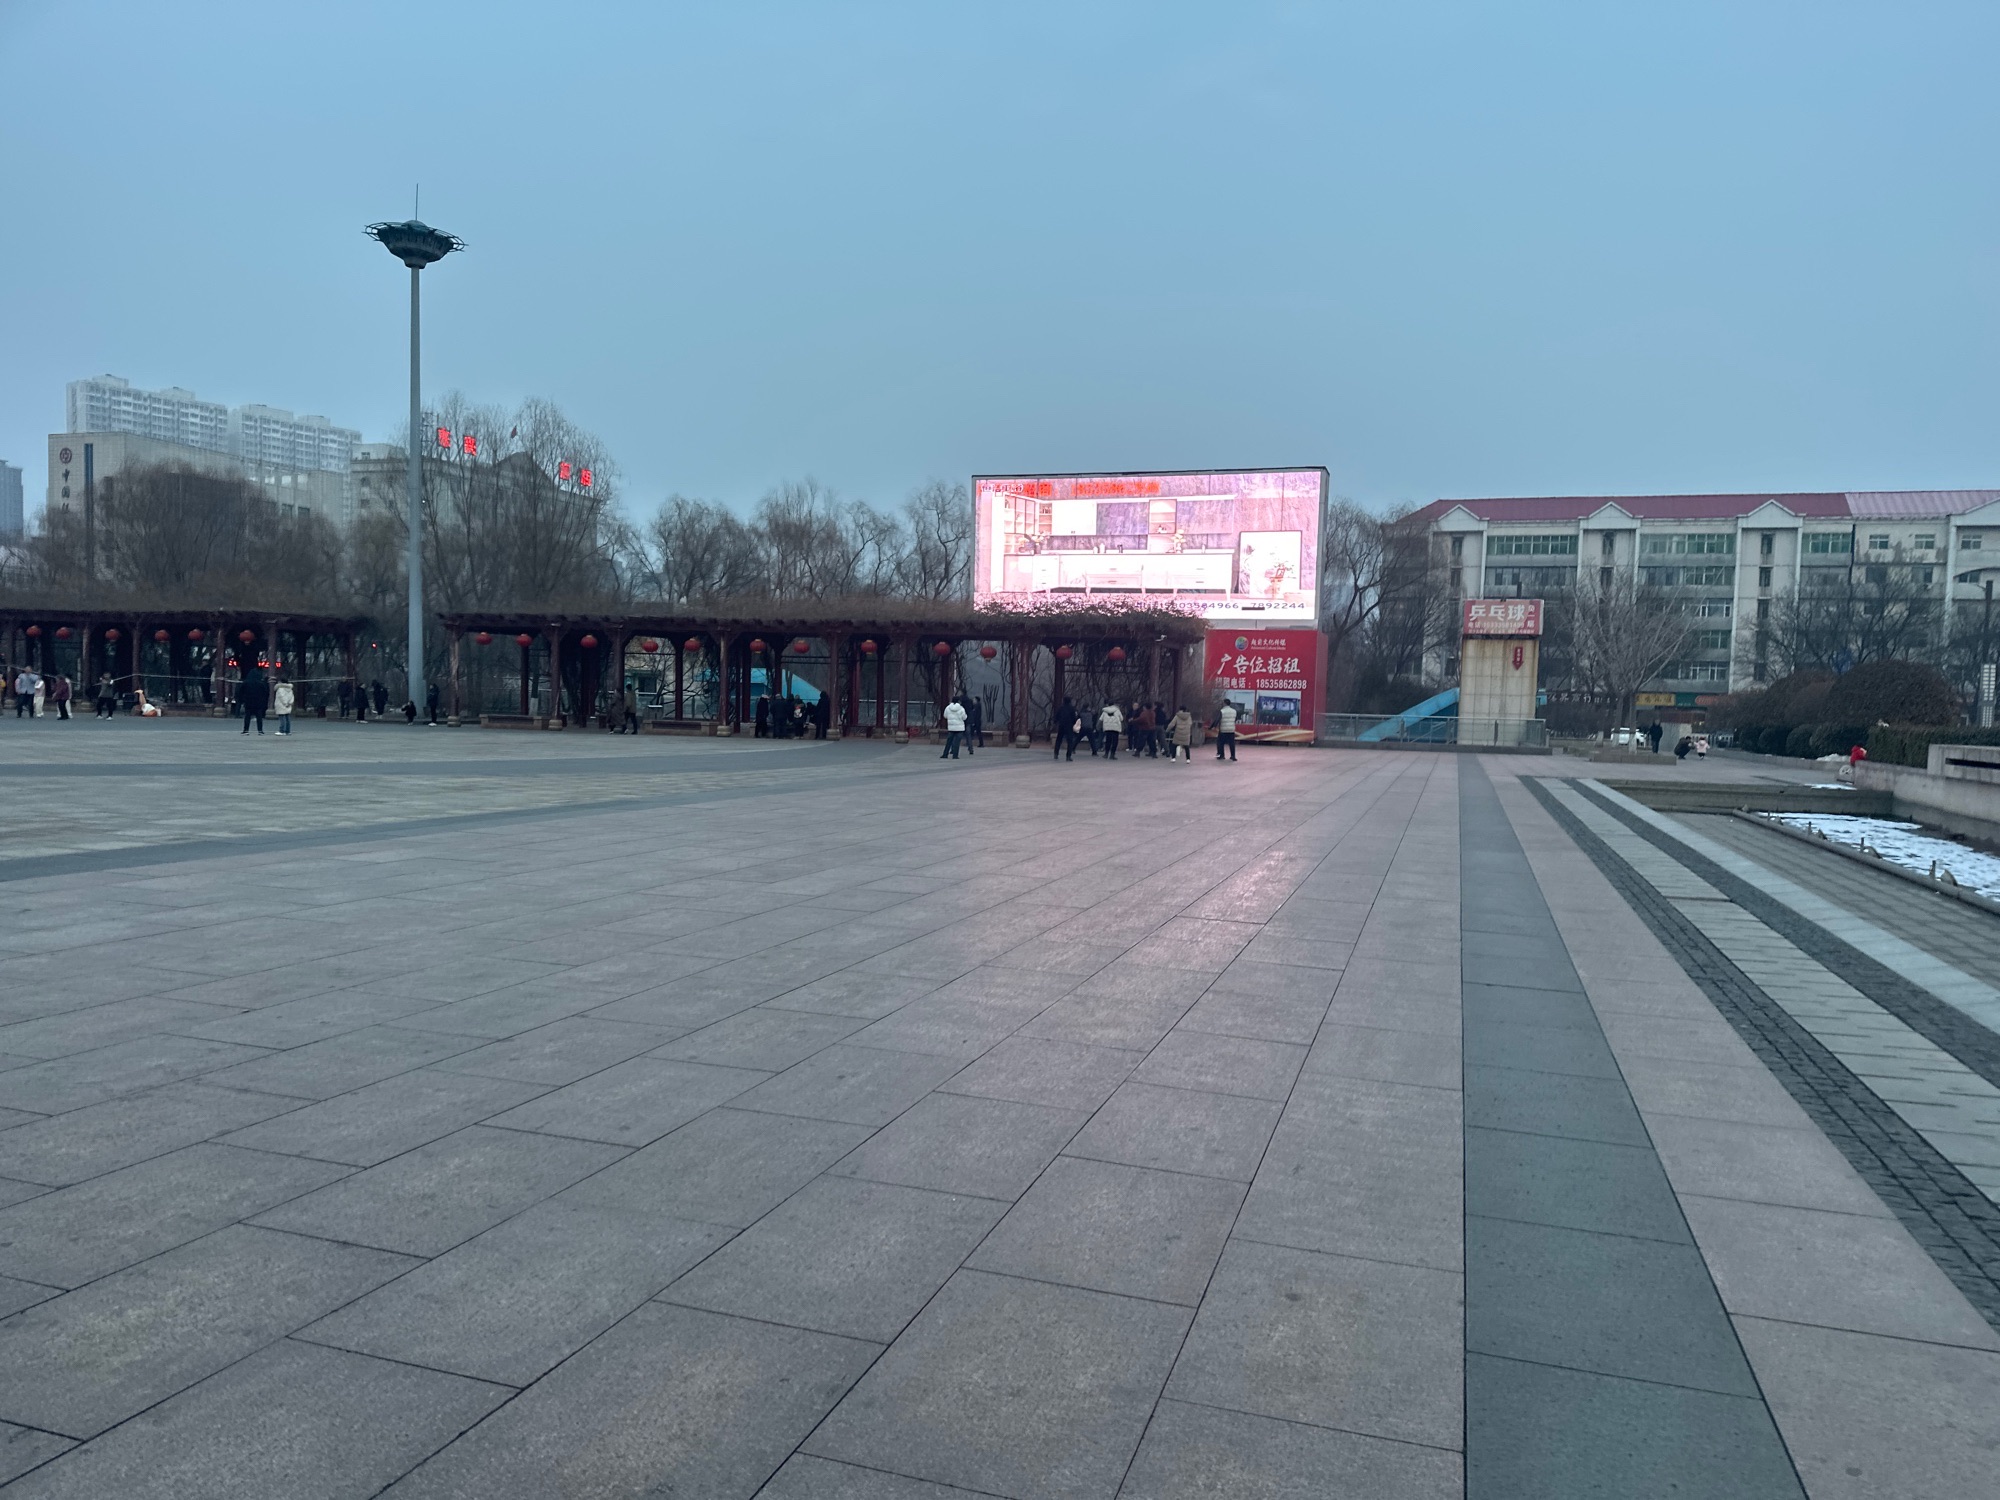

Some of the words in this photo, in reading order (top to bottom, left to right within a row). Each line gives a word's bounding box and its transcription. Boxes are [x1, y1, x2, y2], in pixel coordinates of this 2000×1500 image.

[1468, 604, 1525, 621] 乒乓球
[1216, 653, 1301, 675] 广告位招租
